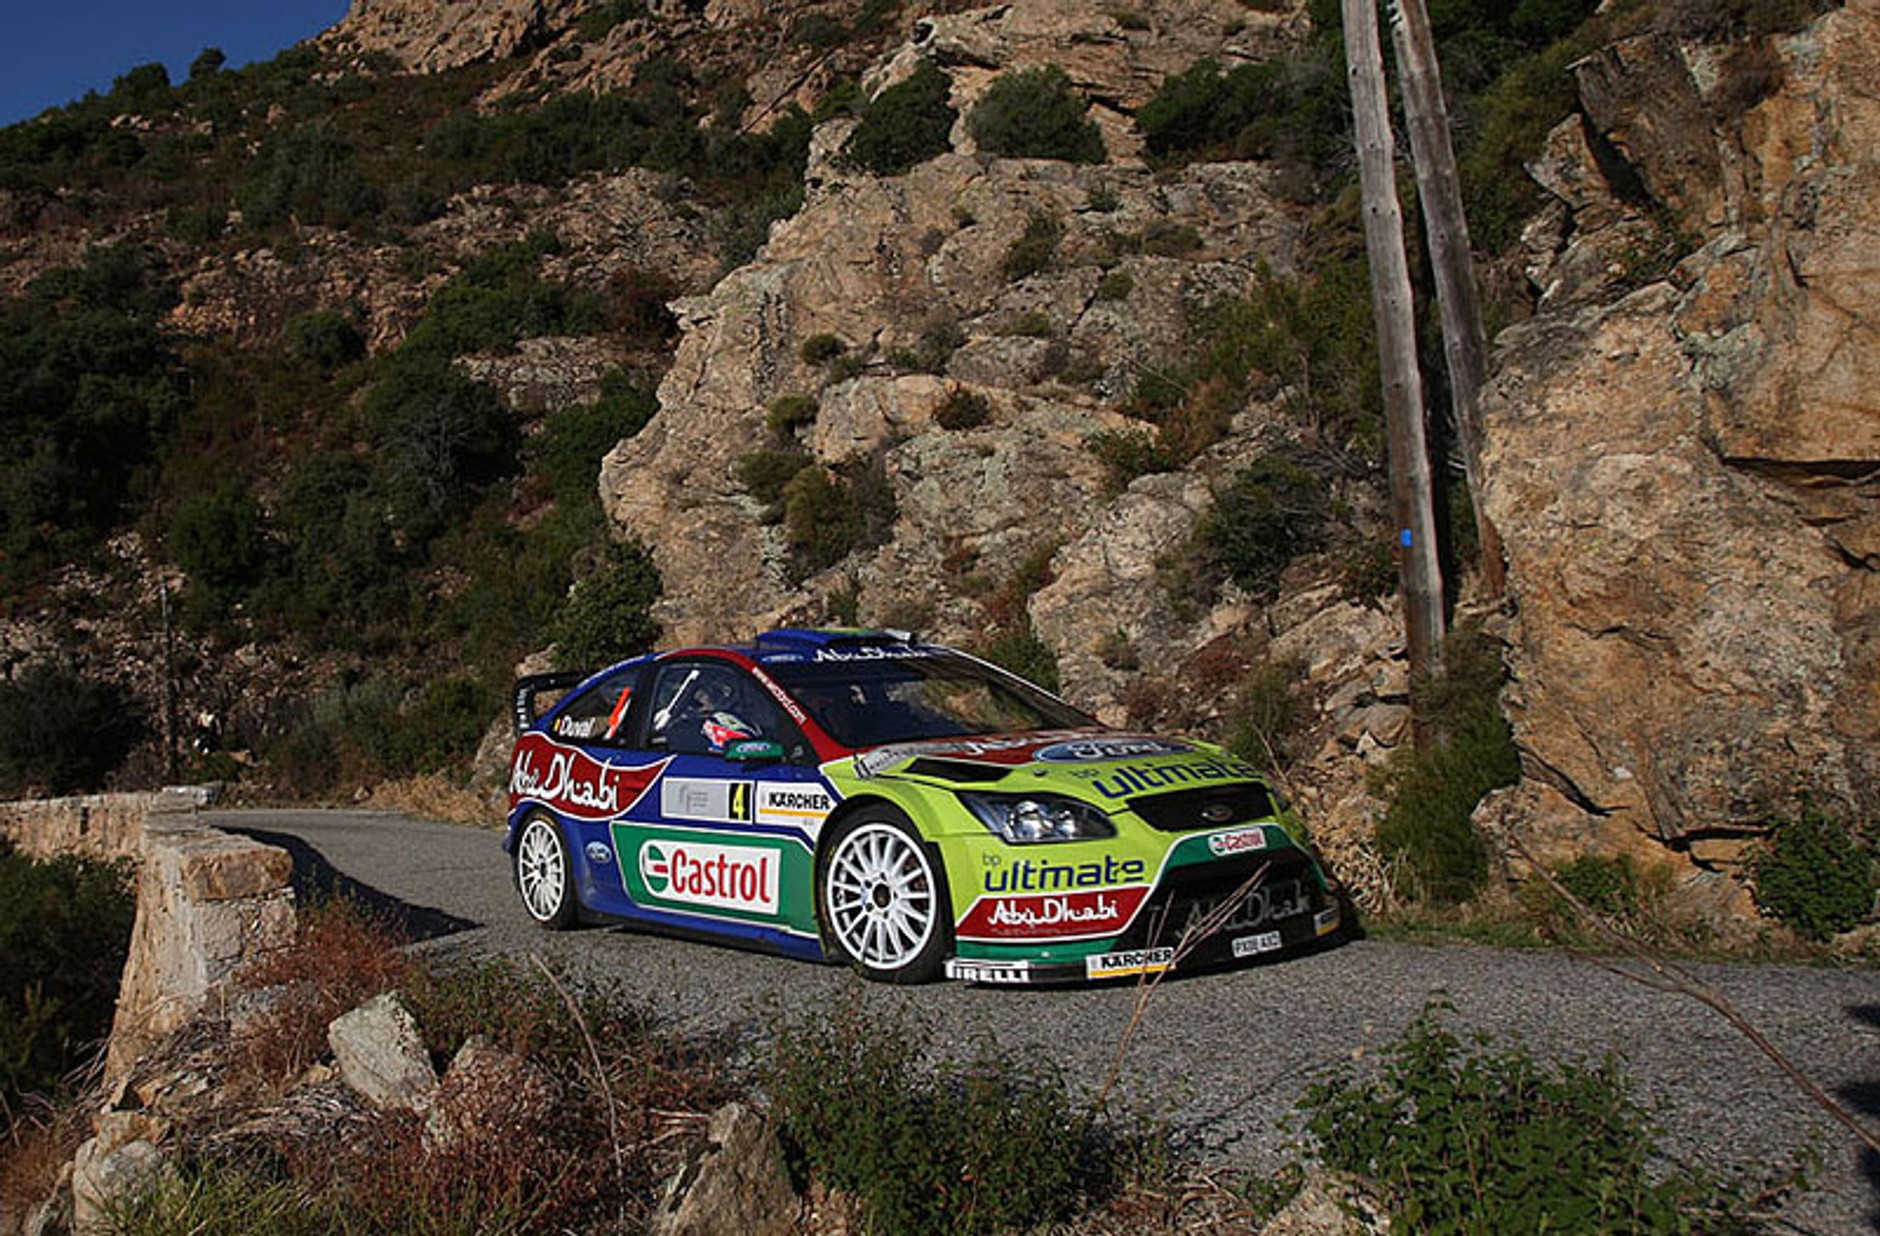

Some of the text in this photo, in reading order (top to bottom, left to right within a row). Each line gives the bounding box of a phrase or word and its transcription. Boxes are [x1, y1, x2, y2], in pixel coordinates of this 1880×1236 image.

[559, 715, 596, 737] Duval
[1092, 758, 1263, 798] ultimate
[733, 783, 745, 820] 4
[672, 849, 771, 903] Castrol
[983, 852, 1001, 867] bp
[984, 854, 1144, 892] ultimate
[1036, 894, 1118, 924] Dhabi
[943, 958, 1030, 983] PIRELLI
